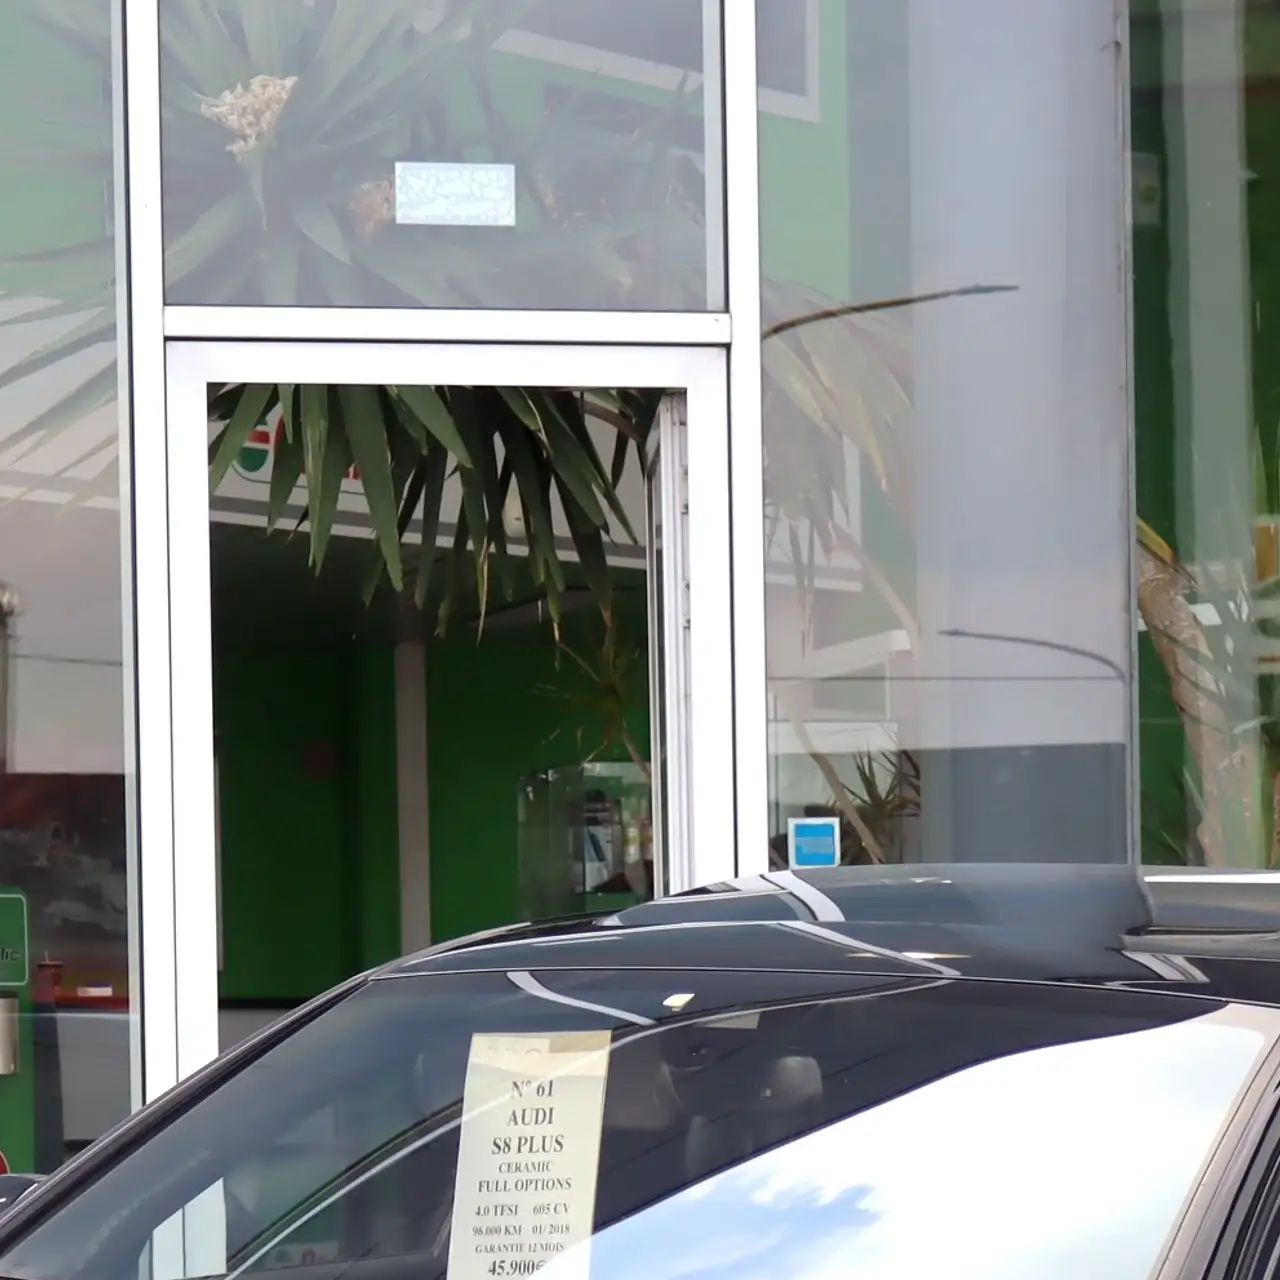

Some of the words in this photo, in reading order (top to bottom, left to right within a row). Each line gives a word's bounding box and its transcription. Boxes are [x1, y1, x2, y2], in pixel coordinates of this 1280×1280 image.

[536, 1079, 554, 1098] 61
[506, 1107, 555, 1127] AUDI
[491, 1136, 512, 1155] S8
[516, 1134, 565, 1154] PLUS
[498, 1161, 554, 1174] CERAMIC
[477, 1180, 511, 1193] FULL
[514, 1177, 573, 1192] OPTIONS
